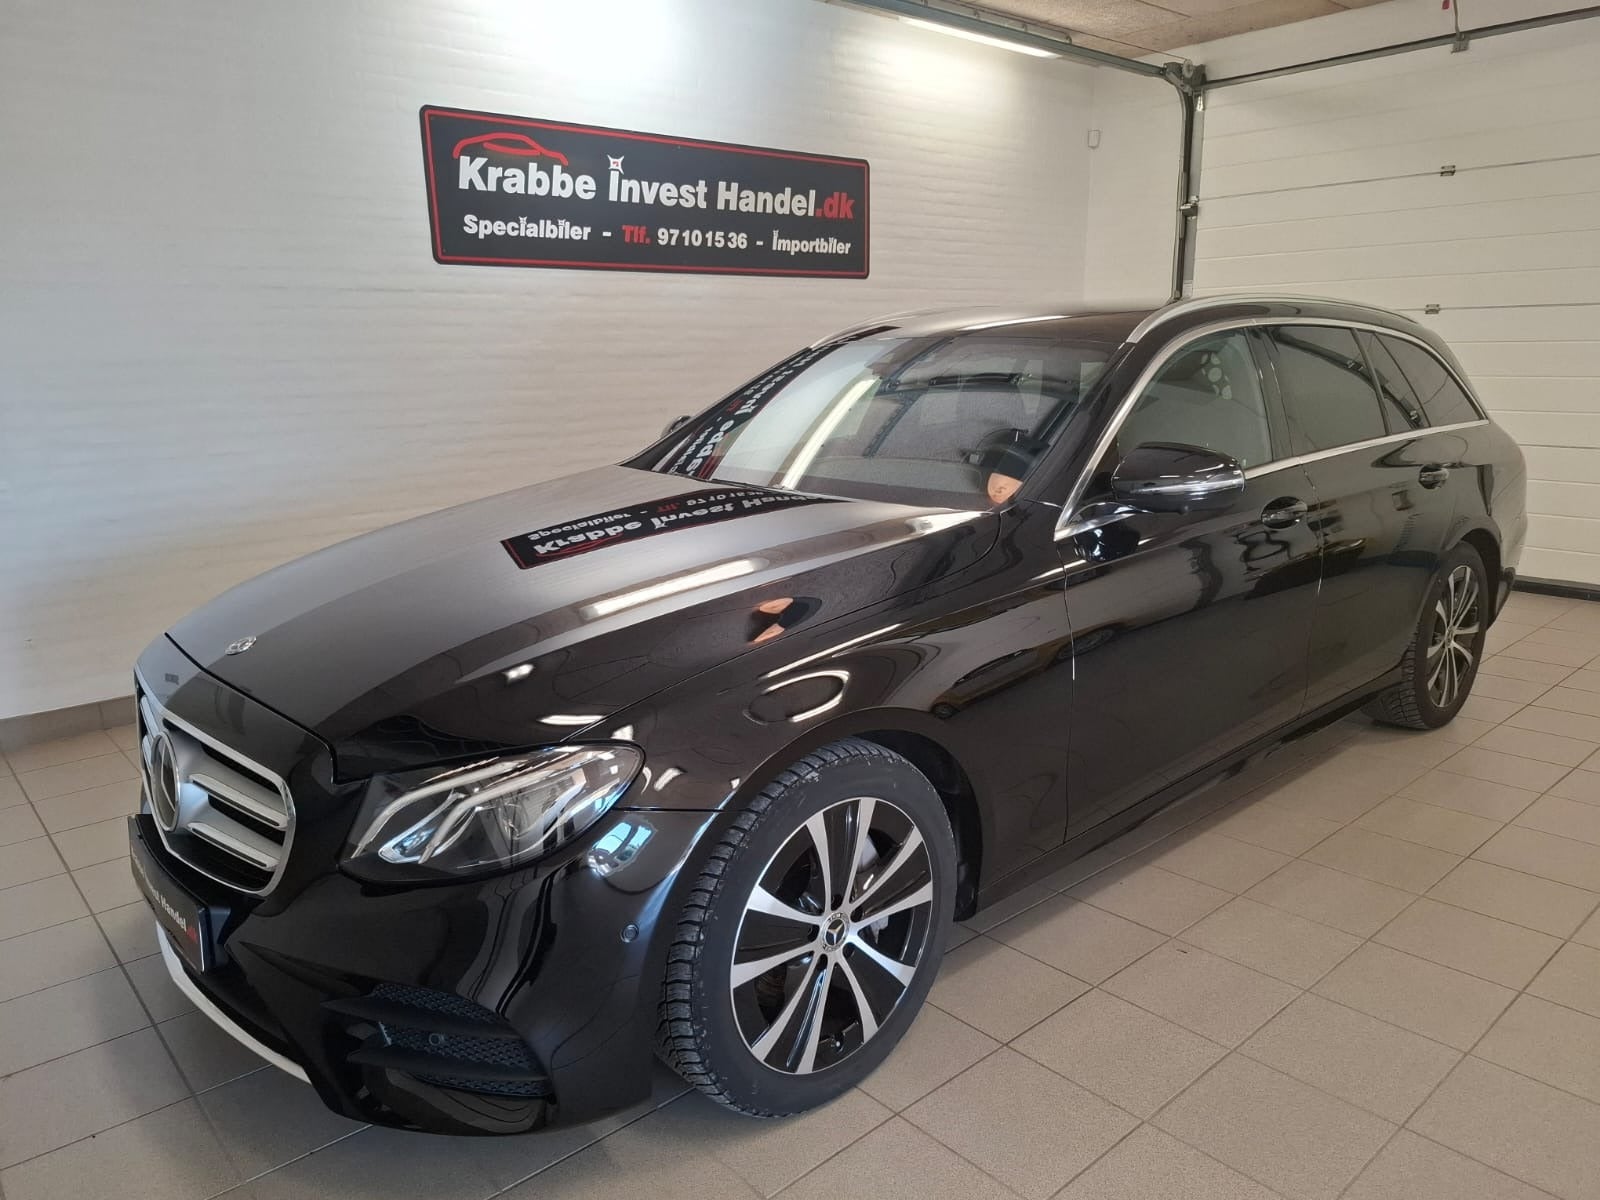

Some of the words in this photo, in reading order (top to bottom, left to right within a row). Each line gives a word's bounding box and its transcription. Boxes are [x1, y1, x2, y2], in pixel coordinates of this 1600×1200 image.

[458, 155, 597, 200] Krabbe
[607, 155, 708, 209] Invest
[716, 180, 855, 219] Handel.dk
[463, 214, 592, 240] Specialbiler
[622, 225, 651, 244] Tlf.
[772, 229, 851, 256] Importbiler
